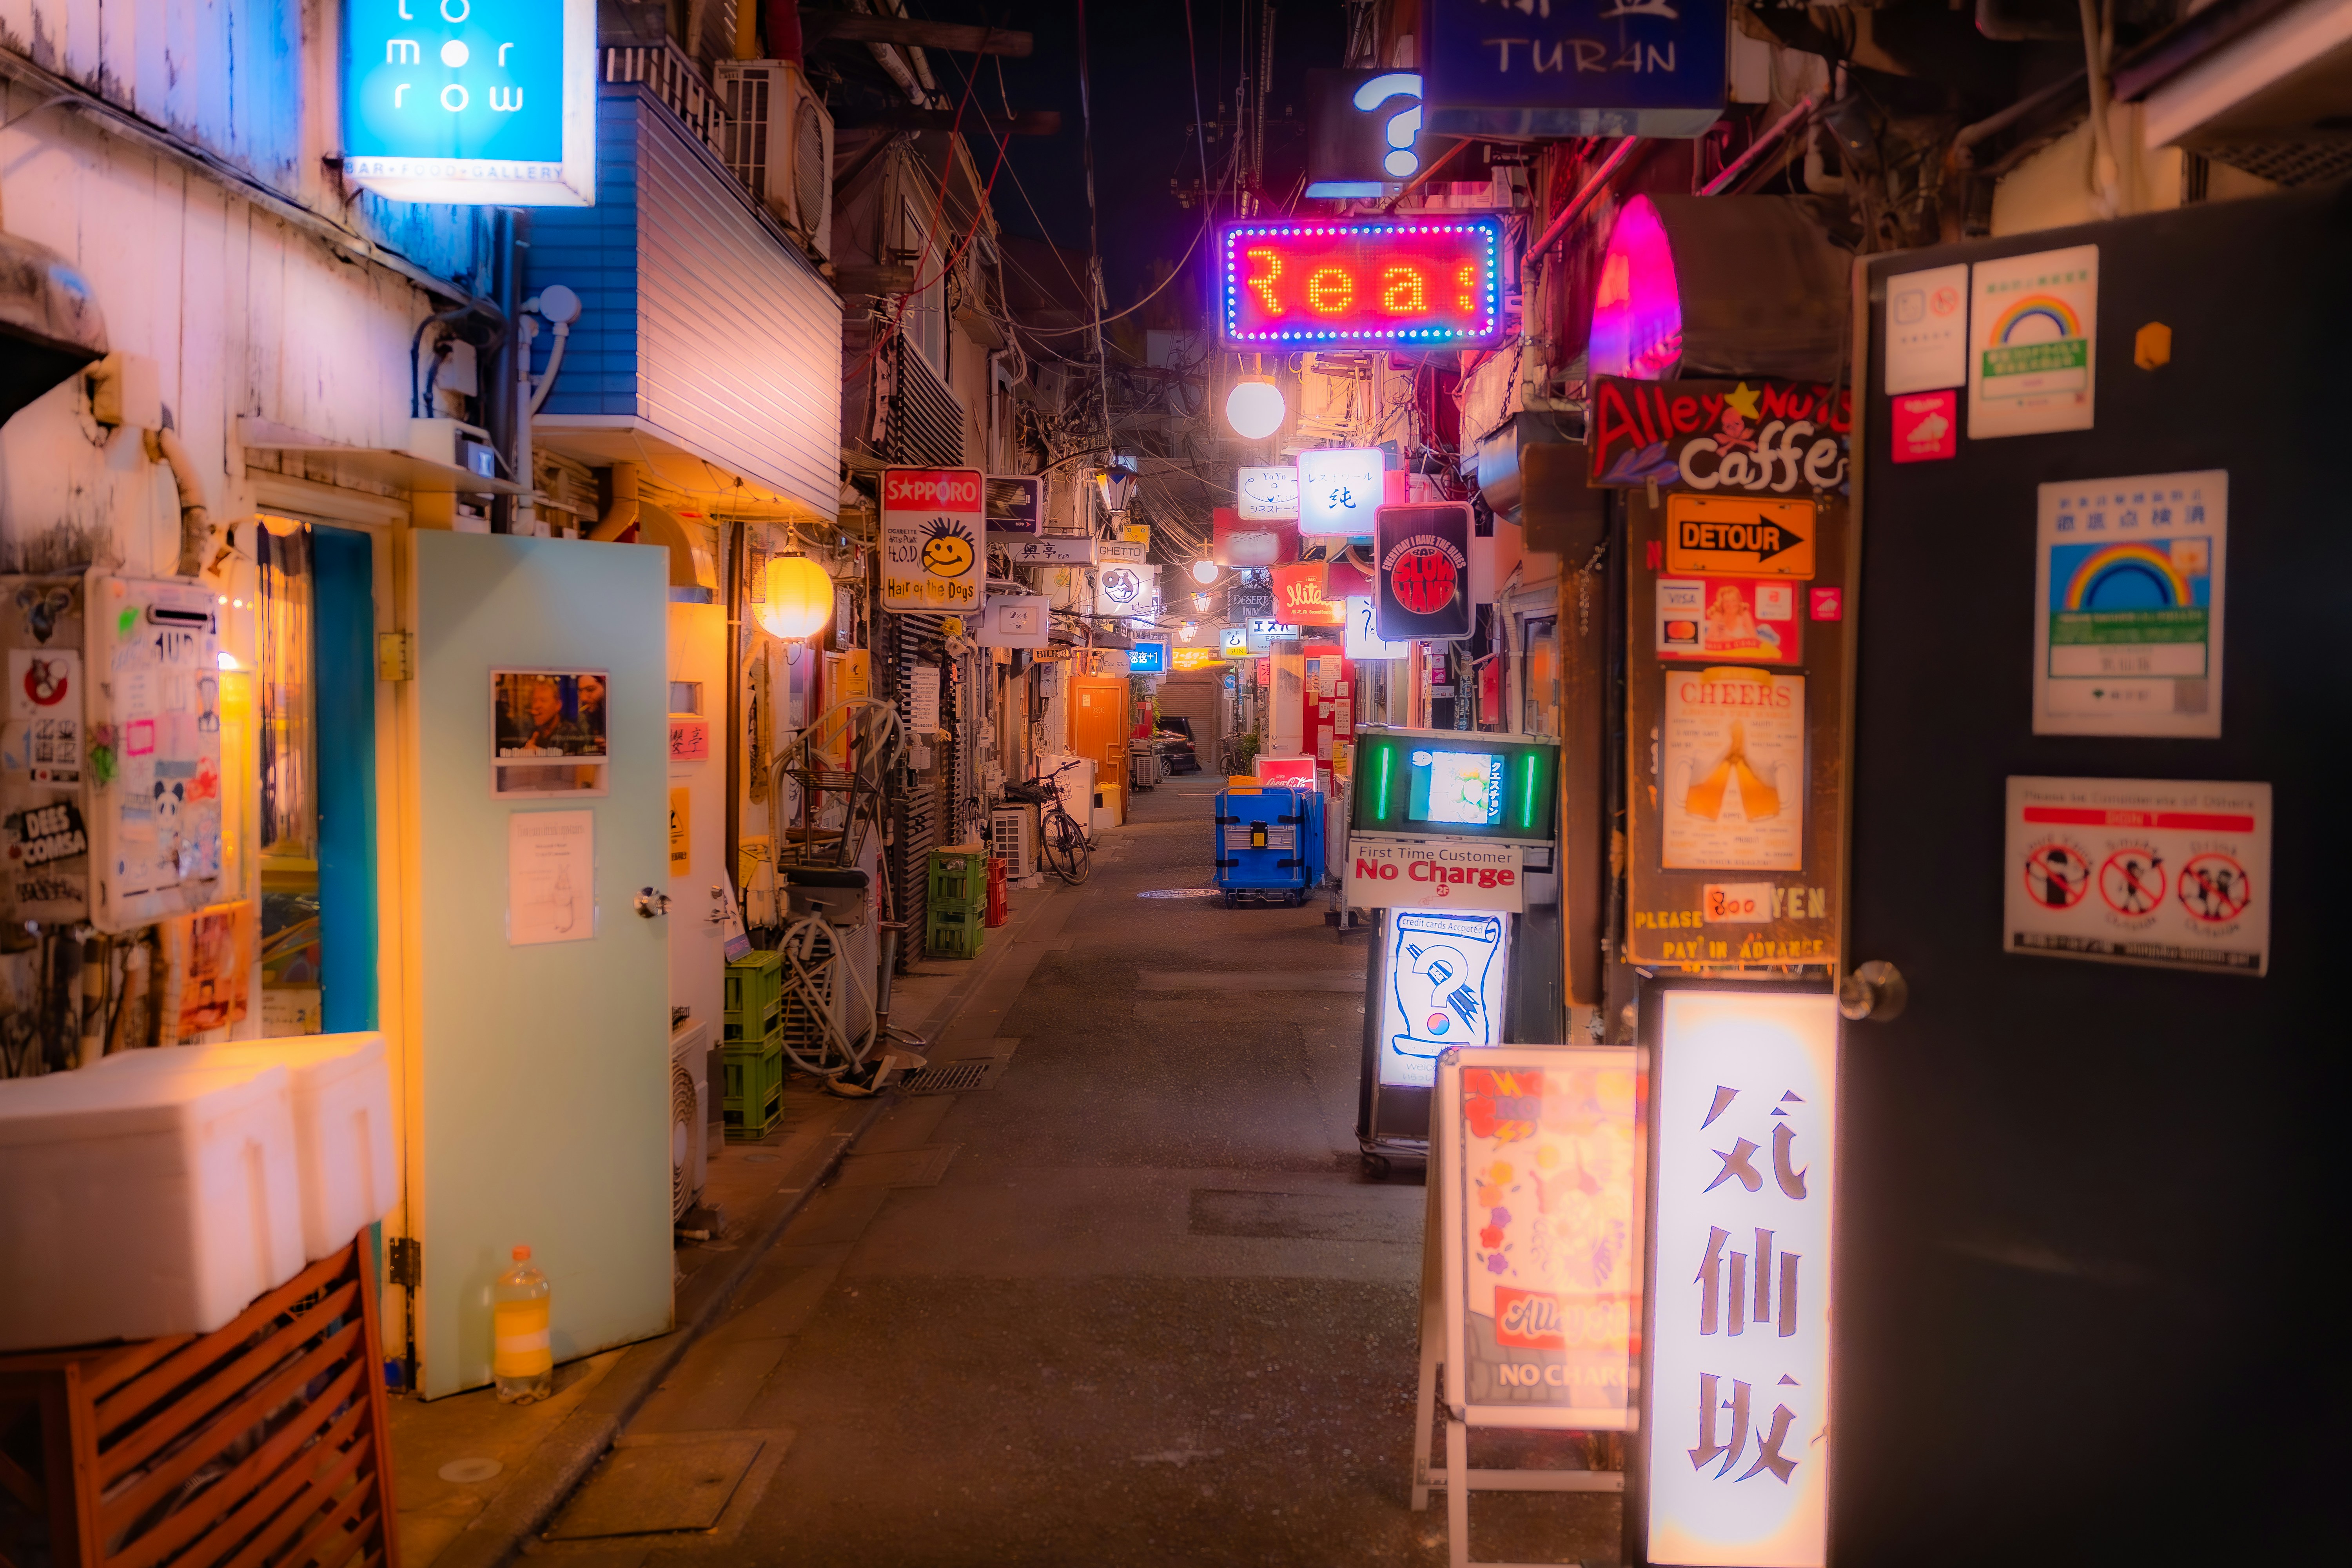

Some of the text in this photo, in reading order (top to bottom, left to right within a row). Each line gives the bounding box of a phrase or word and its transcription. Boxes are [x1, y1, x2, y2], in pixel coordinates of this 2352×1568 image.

[1482, 38, 1676, 73] TURAN
[472, 166, 564, 179] GALLERY
[1593, 381, 1725, 478] Alley
[1679, 420, 1849, 493] Caffe
[1682, 523, 1780, 551] DETOUR
[1099, 546, 1141, 557] GHETTO
[1381, 537, 1411, 572] EVERYDAY
[1414, 534, 1436, 546] HAVE
[1435, 536, 1451, 551] THE
[1447, 545, 1467, 570] BLUES
[1412, 548, 1436, 556] BAR
[1393, 550, 1455, 582] SLOW
[888, 578, 974, 602] Hair of the Dogs
[1234, 594, 1269, 607] DESERT
[1393, 581, 1455, 613] HAND
[1242, 606, 1261, 616] INN
[1129, 651, 1158, 664] 深夜+1
[1680, 682, 1792, 707] CHEERS
[1359, 846, 1513, 863] First Time Customer
[1356, 858, 1515, 889] No Charge
[1438, 886, 1450, 895] 2F
[1771, 887, 1826, 919] YEN
[1402, 918, 1424, 927] credit
[1426, 921, 1446, 929] cards
[1634, 911, 1704, 929] PLEASE
[1662, 940, 1698, 960] PAY
[1709, 940, 1728, 959] IN
[1406, 1060, 1436, 1071] welc
[1499, 1363, 1541, 1387] NO
